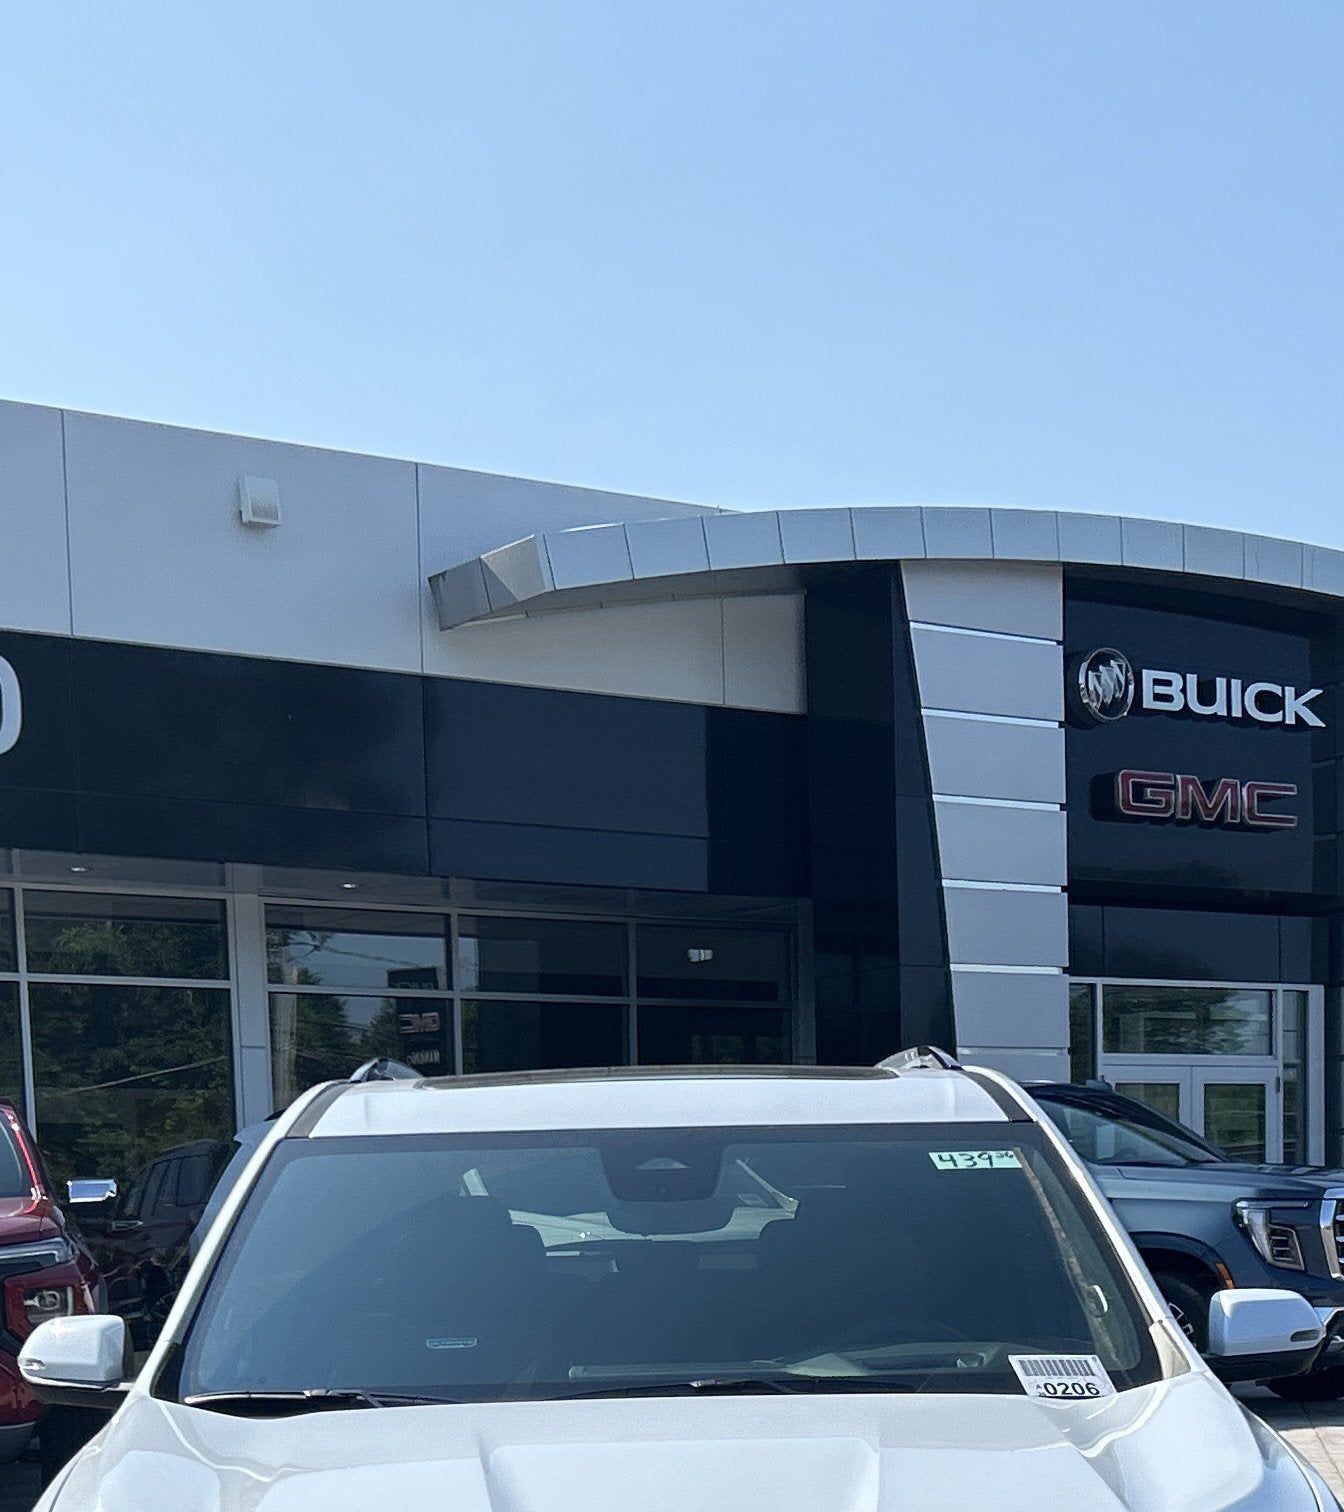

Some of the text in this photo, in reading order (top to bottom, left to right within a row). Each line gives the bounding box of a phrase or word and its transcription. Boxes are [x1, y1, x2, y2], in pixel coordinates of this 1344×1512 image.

[1141, 668, 1326, 728] BUICK
[1117, 769, 1298, 827] GMC
[937, 1151, 993, 1168] 439
[1043, 1382, 1100, 1396] 0206
